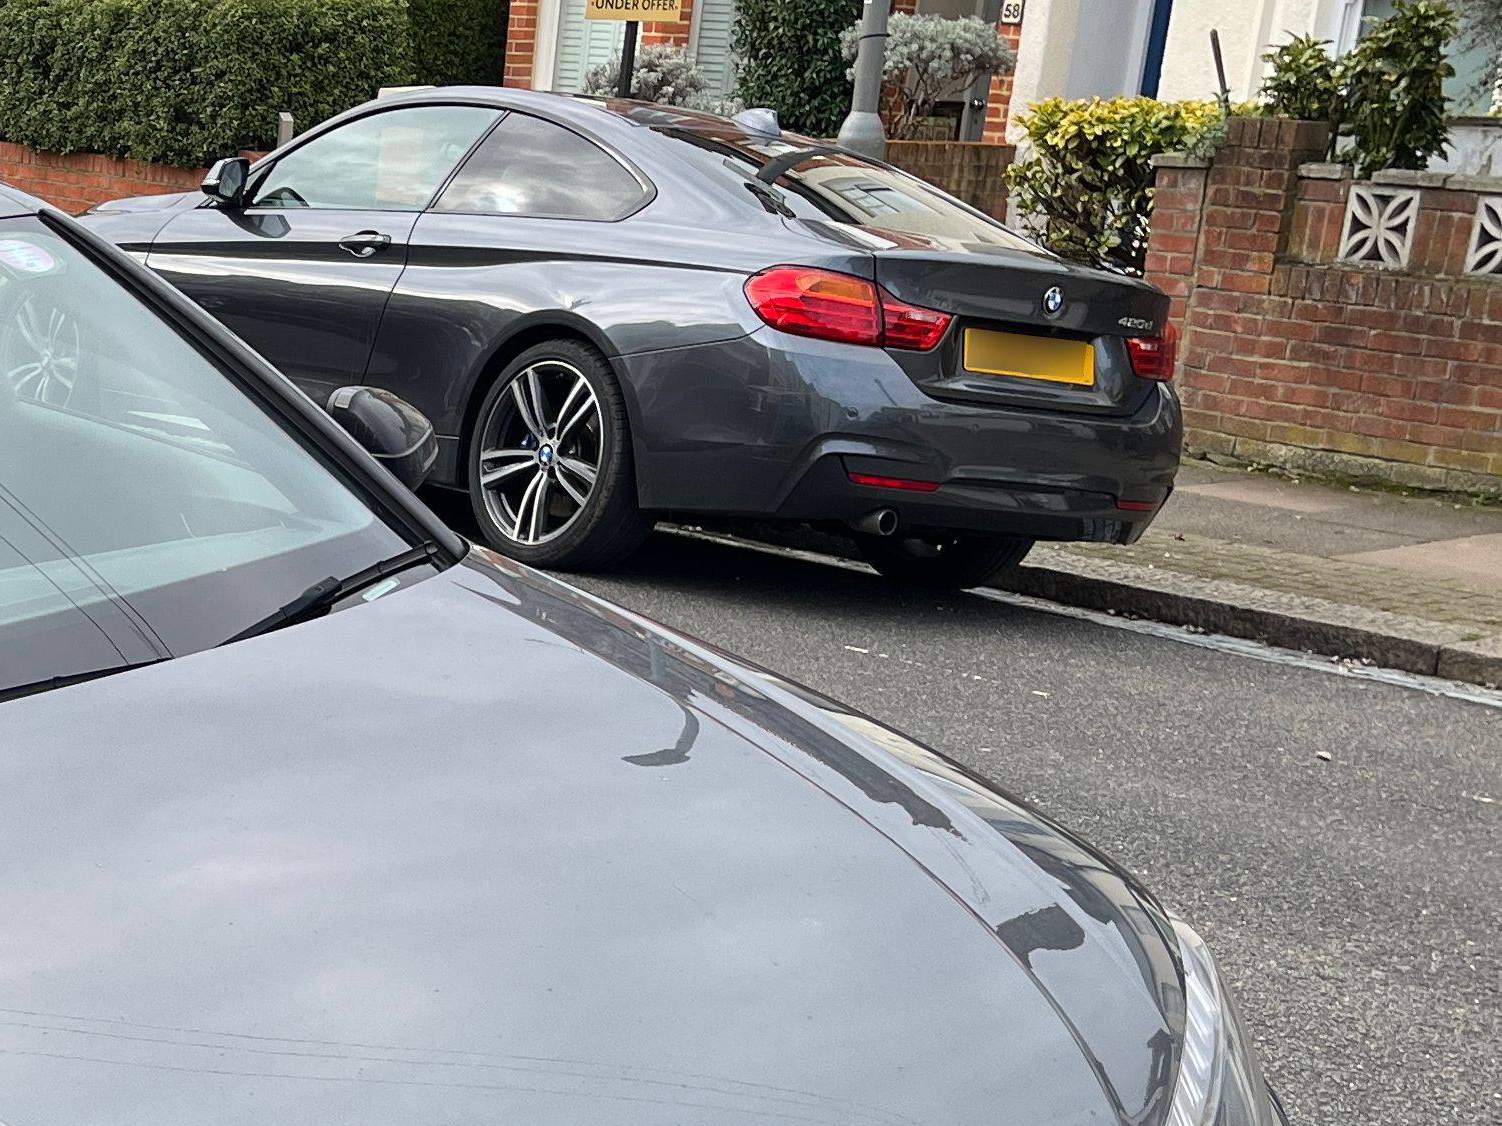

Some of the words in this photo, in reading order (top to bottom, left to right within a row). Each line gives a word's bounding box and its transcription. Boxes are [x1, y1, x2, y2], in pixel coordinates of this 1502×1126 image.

[595, 0, 638, 10] UNDER
[641, 0, 675, 11] OFFER
[1003, 3, 1020, 19] 58
[1117, 316, 1154, 331] 420d
